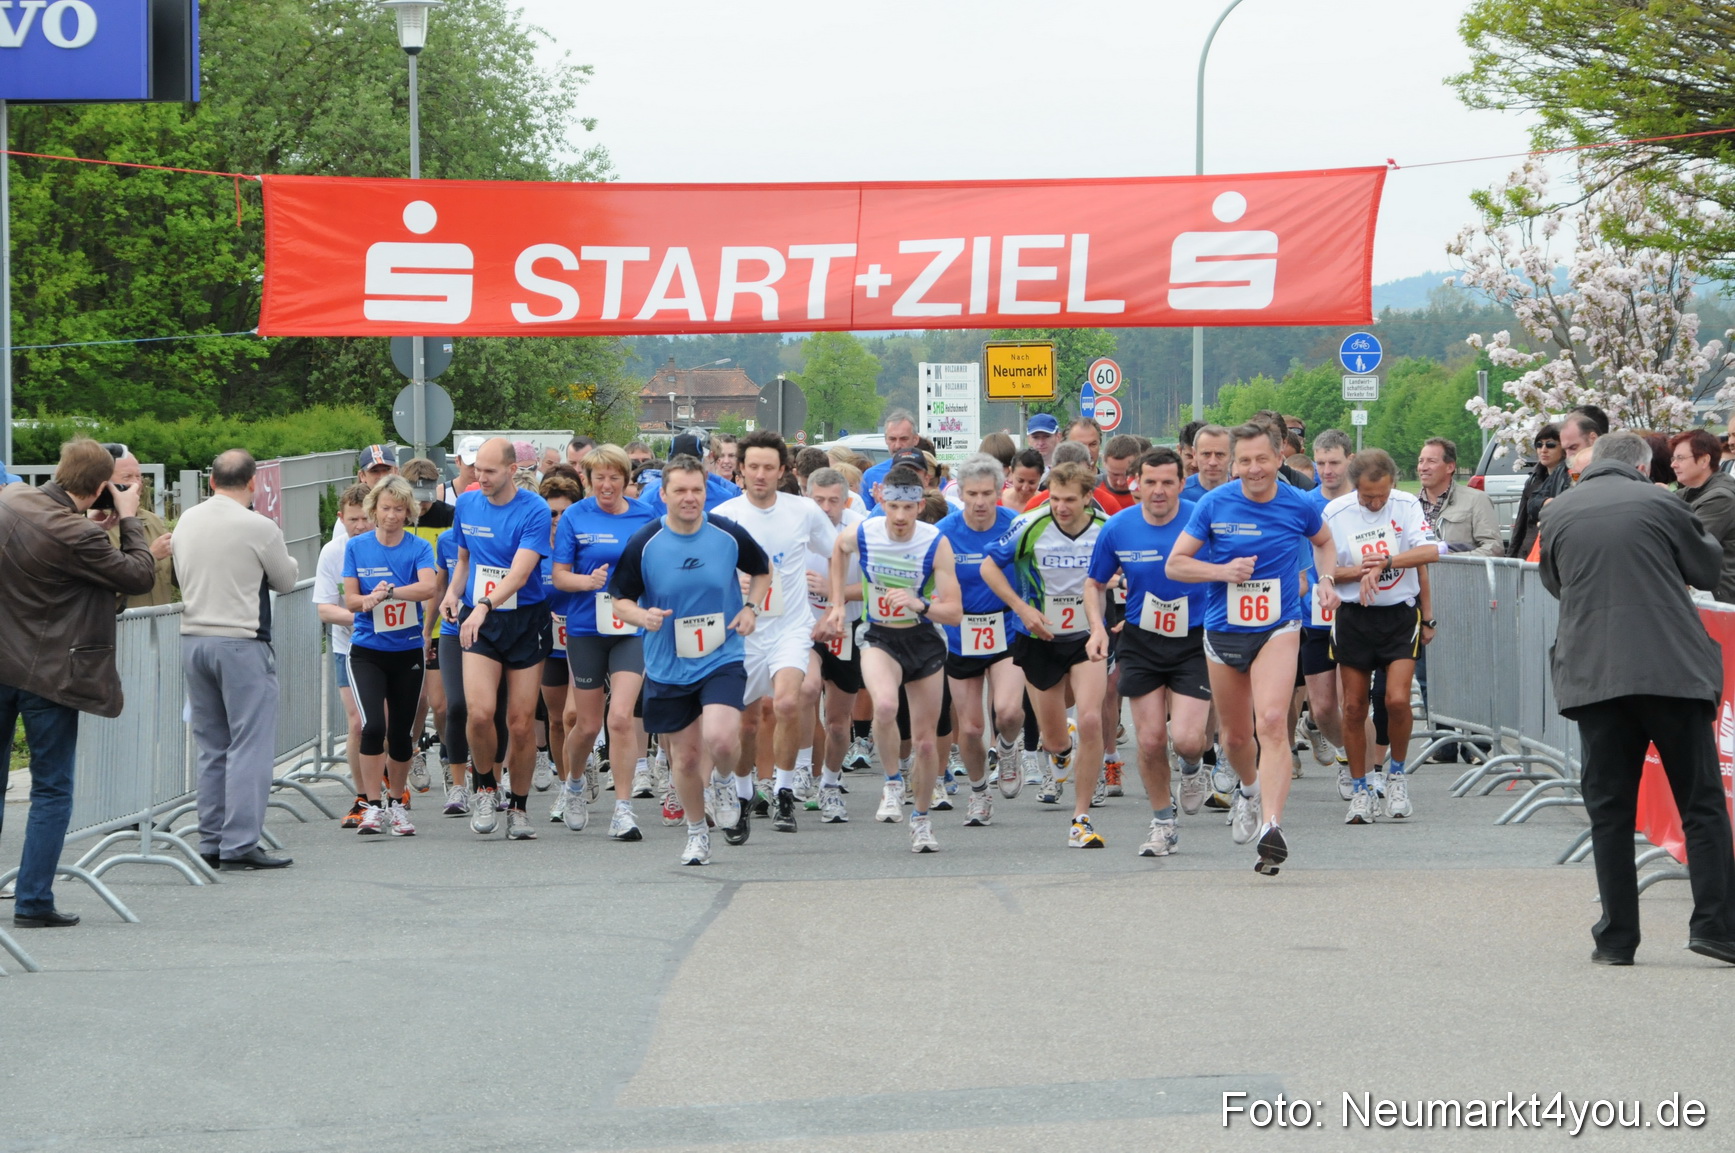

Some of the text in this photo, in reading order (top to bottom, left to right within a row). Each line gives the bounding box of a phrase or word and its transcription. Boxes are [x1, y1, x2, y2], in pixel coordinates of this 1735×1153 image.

[993, 364, 1048, 378] Neumarkt
[1096, 369, 1114, 384] 60
[1355, 530, 1376, 541] MEYER
[482, 567, 500, 575] MEYER
[1043, 555, 1094, 569] BOC
[1151, 598, 1172, 608] MEYER
[1240, 595, 1269, 621] 66
[384, 602, 407, 627] 67
[1061, 607, 1075, 629] 2
[1154, 610, 1176, 633] 16
[694, 628, 704, 652] 1
[971, 627, 995, 650] 73
